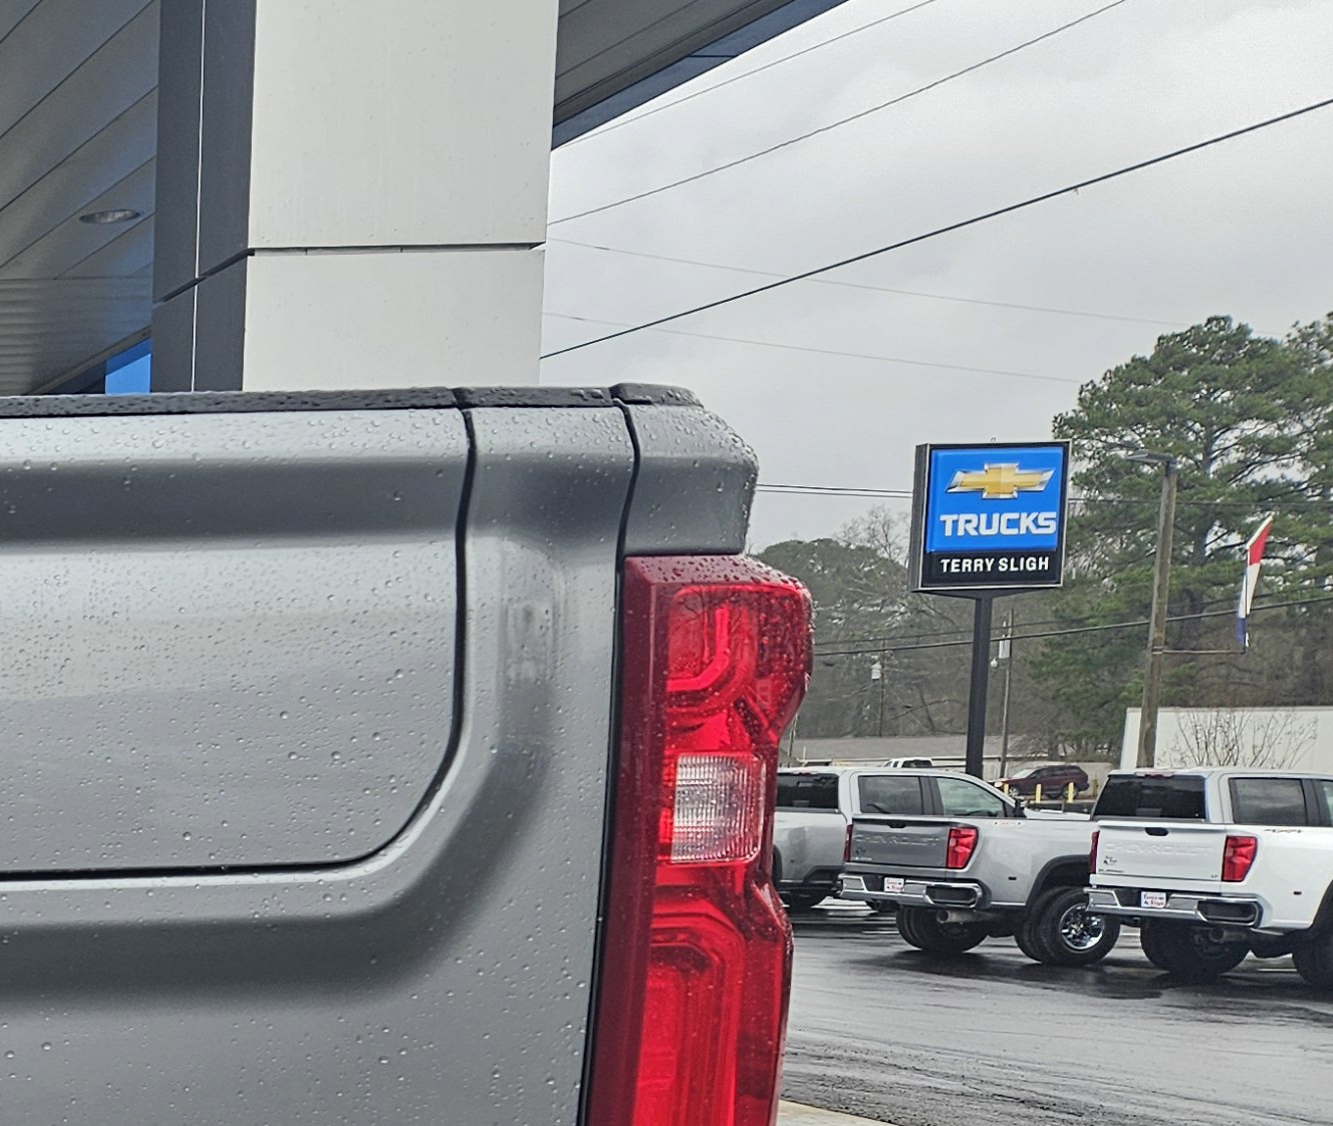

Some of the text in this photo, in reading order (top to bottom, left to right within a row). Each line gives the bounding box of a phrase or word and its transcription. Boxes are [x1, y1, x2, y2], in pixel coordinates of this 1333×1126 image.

[940, 512, 1057, 536] TRUCKS
[940, 557, 1049, 573] TERRY SLIGH
